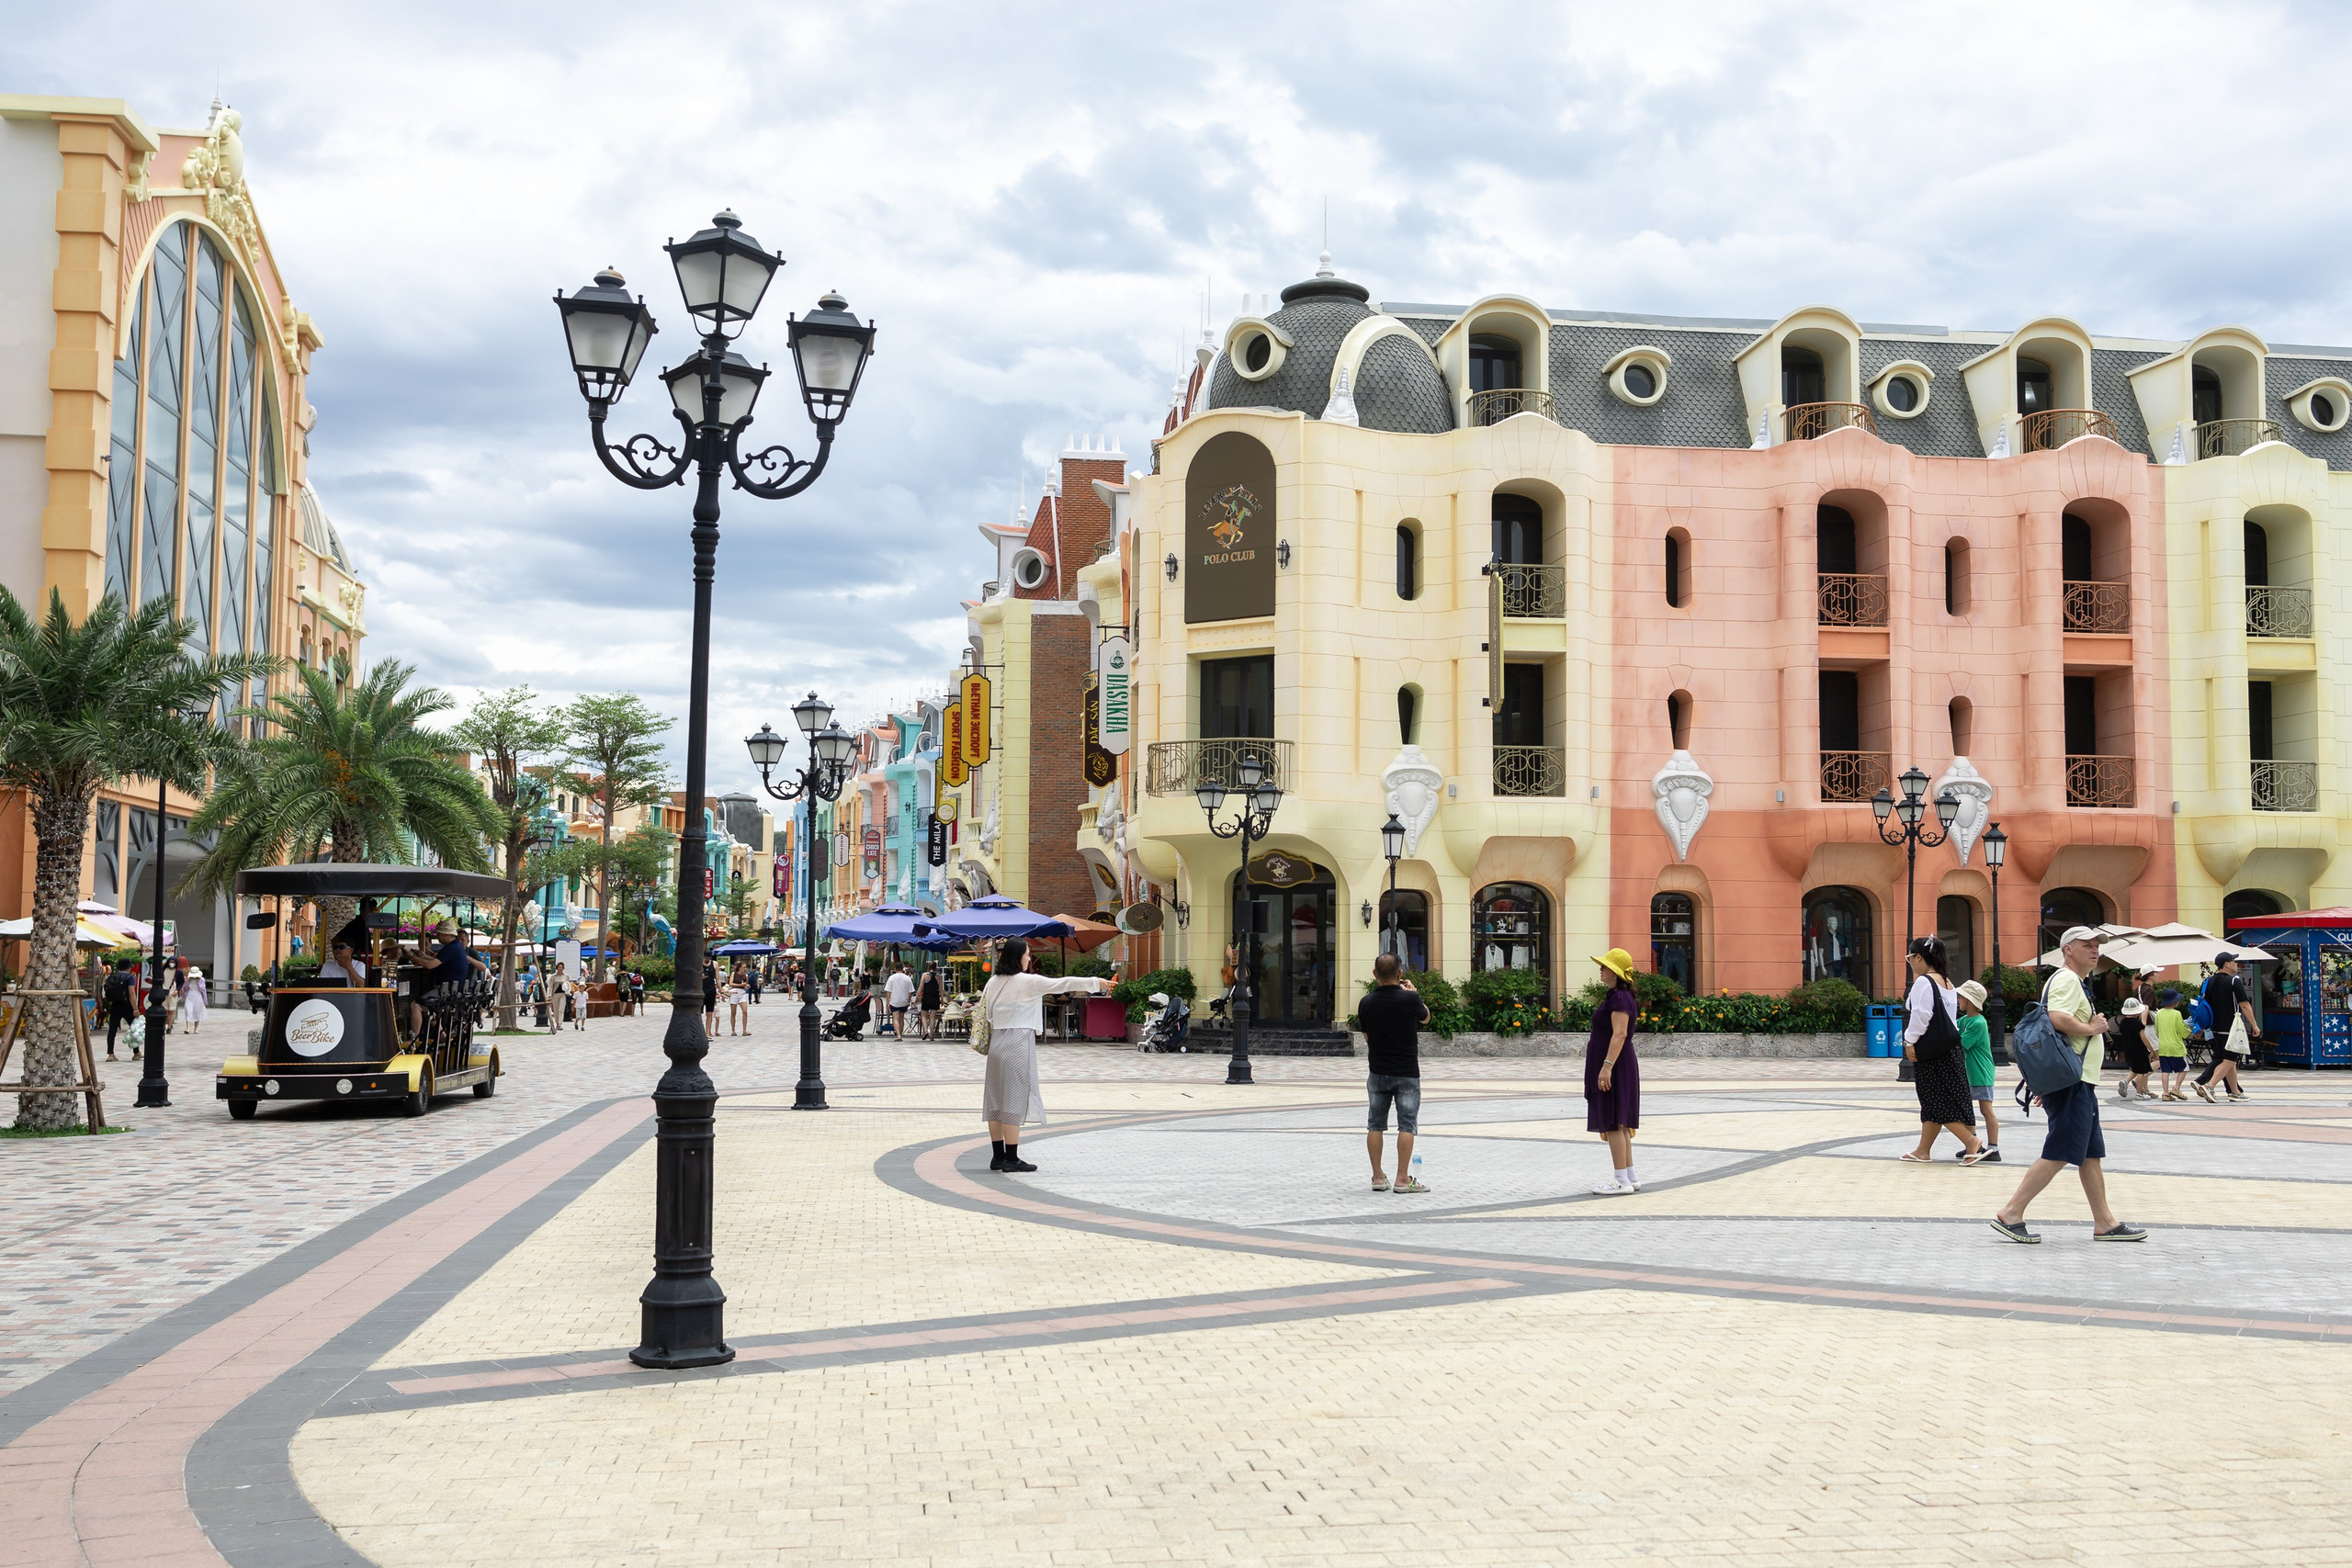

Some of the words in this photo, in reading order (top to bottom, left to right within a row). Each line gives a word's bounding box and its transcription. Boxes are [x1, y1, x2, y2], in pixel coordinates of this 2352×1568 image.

[1204, 552, 1229, 566] POLO
[1230, 549, 1256, 562] CLUB
[970, 682, 981, 720] ВЬЕТНАМ
[1106, 673, 1129, 734] DASAKHA
[952, 711, 960, 739] SPORT
[969, 721, 980, 758] ЭКСПОРТ
[951, 740, 960, 779] FASHION
[933, 846, 941, 861] THE
[290, 1029, 312, 1042] Beer
[311, 1030, 334, 1043] Bike
